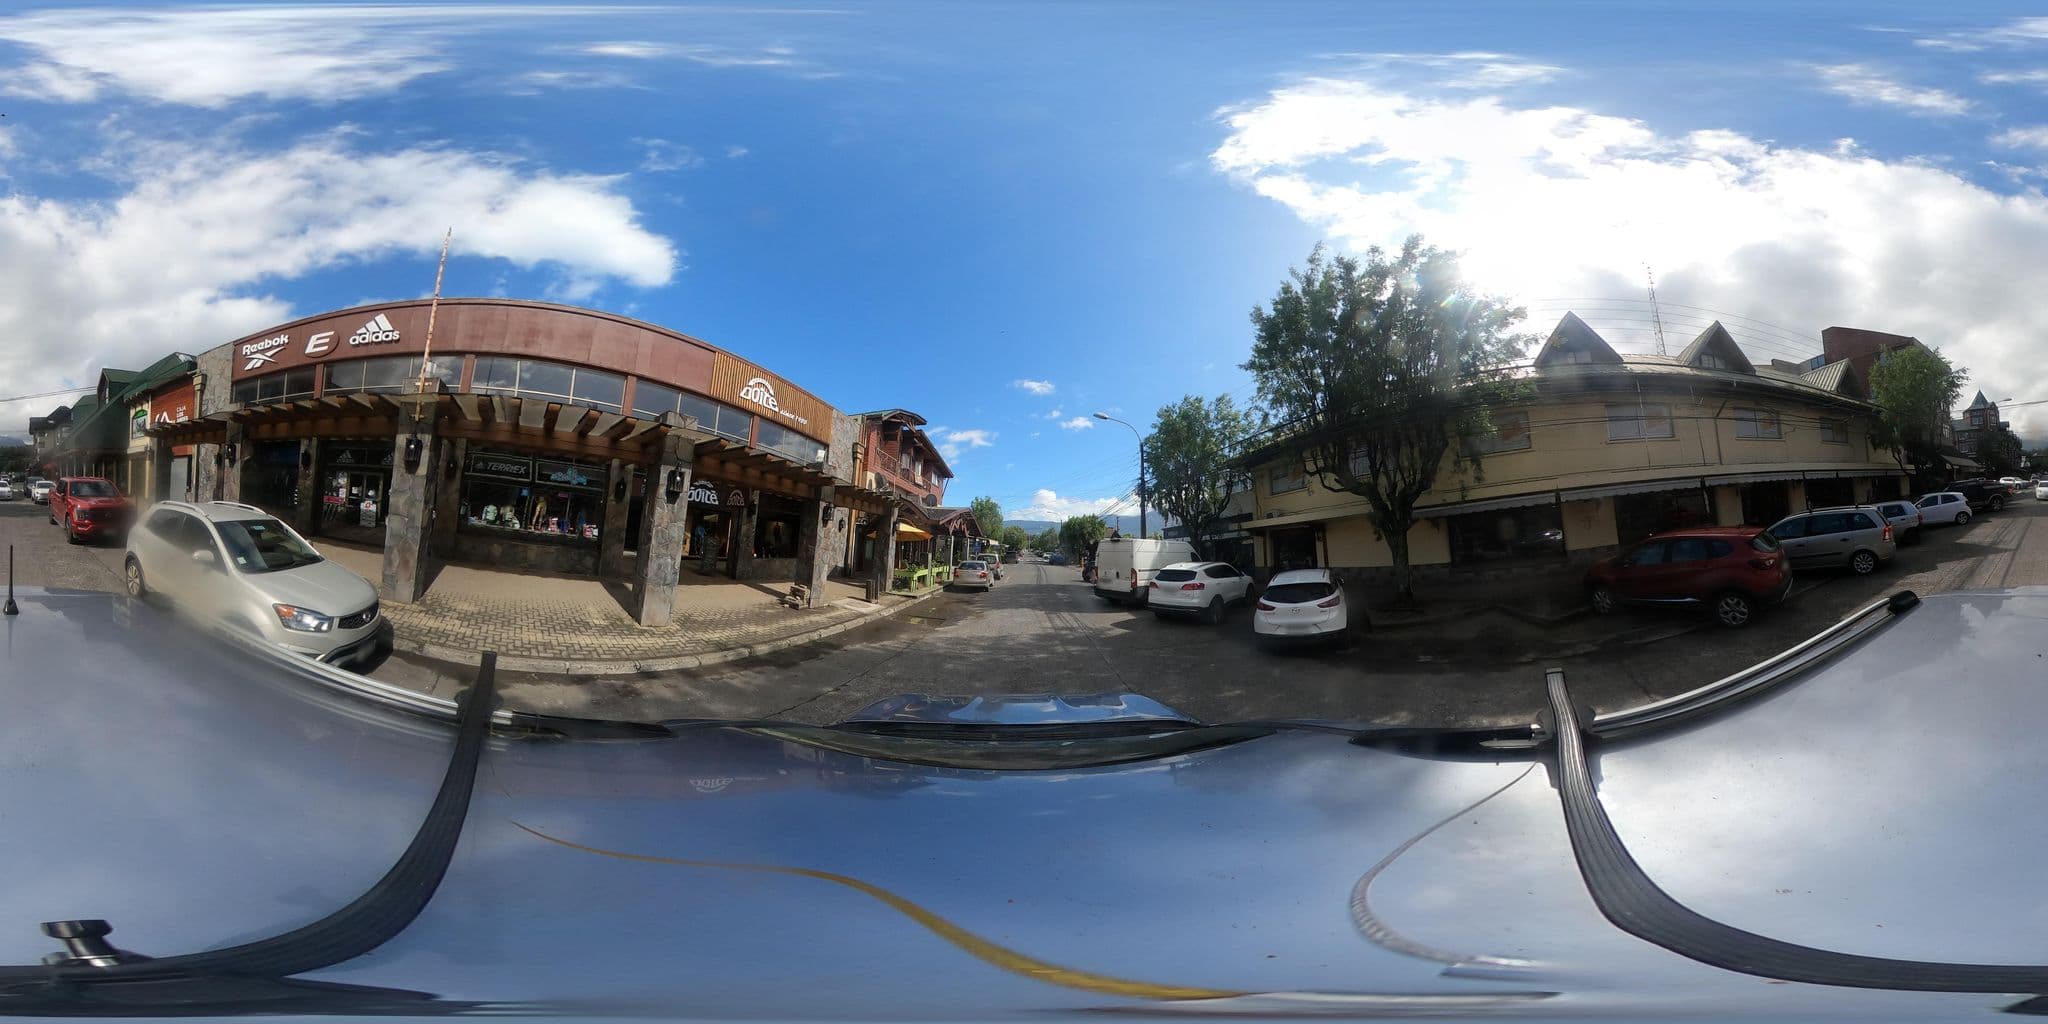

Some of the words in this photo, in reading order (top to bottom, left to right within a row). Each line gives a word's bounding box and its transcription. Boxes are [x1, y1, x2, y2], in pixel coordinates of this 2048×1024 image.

[242, 334, 289, 356] Reebok
[304, 331, 335, 354] E
[349, 329, 400, 345] adidas
